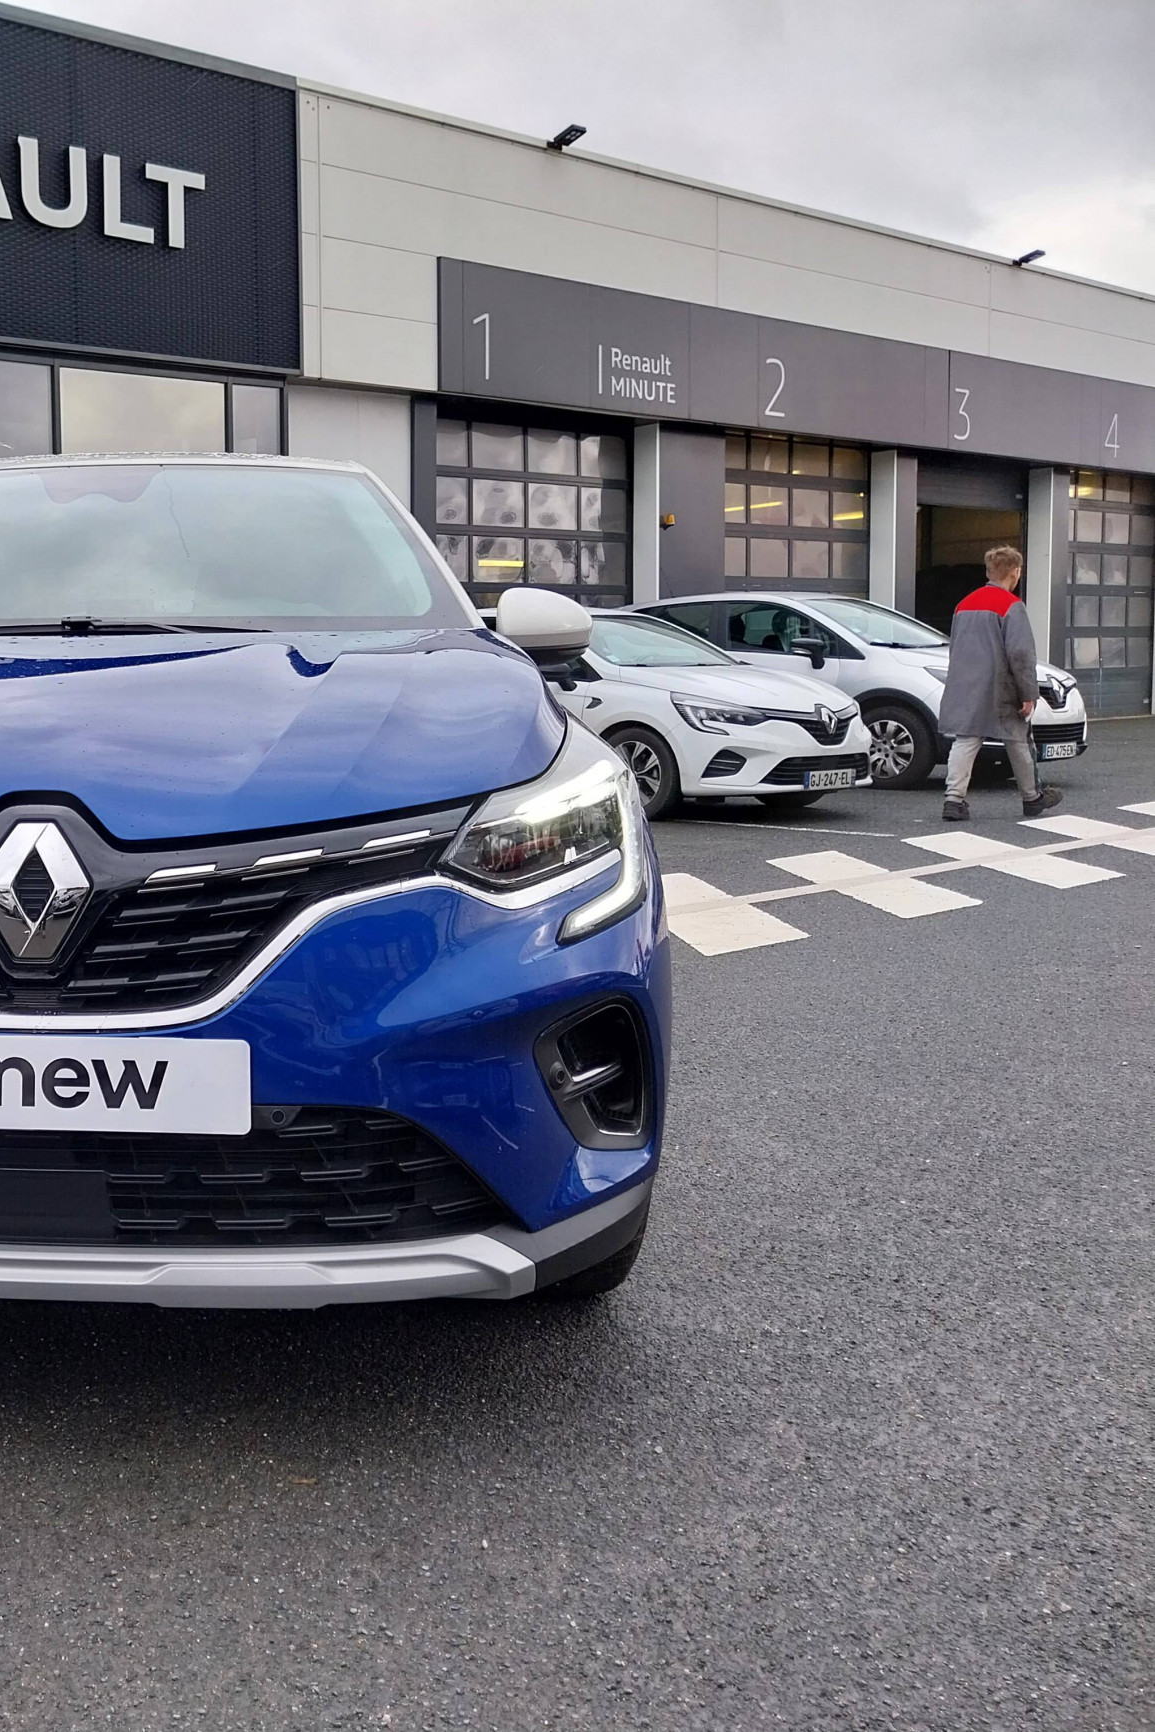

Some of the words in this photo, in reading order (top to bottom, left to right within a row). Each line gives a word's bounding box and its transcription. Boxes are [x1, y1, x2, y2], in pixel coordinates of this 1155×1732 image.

[473, 313, 490, 380] 1
[611, 347, 672, 376] Renault
[611, 376, 676, 404] MINUTE
[764, 358, 786, 418] 2
[953, 388, 971, 441] 3
[1105, 413, 1120, 458] 4
[810, 771, 850, 787] GJ-247-EL
